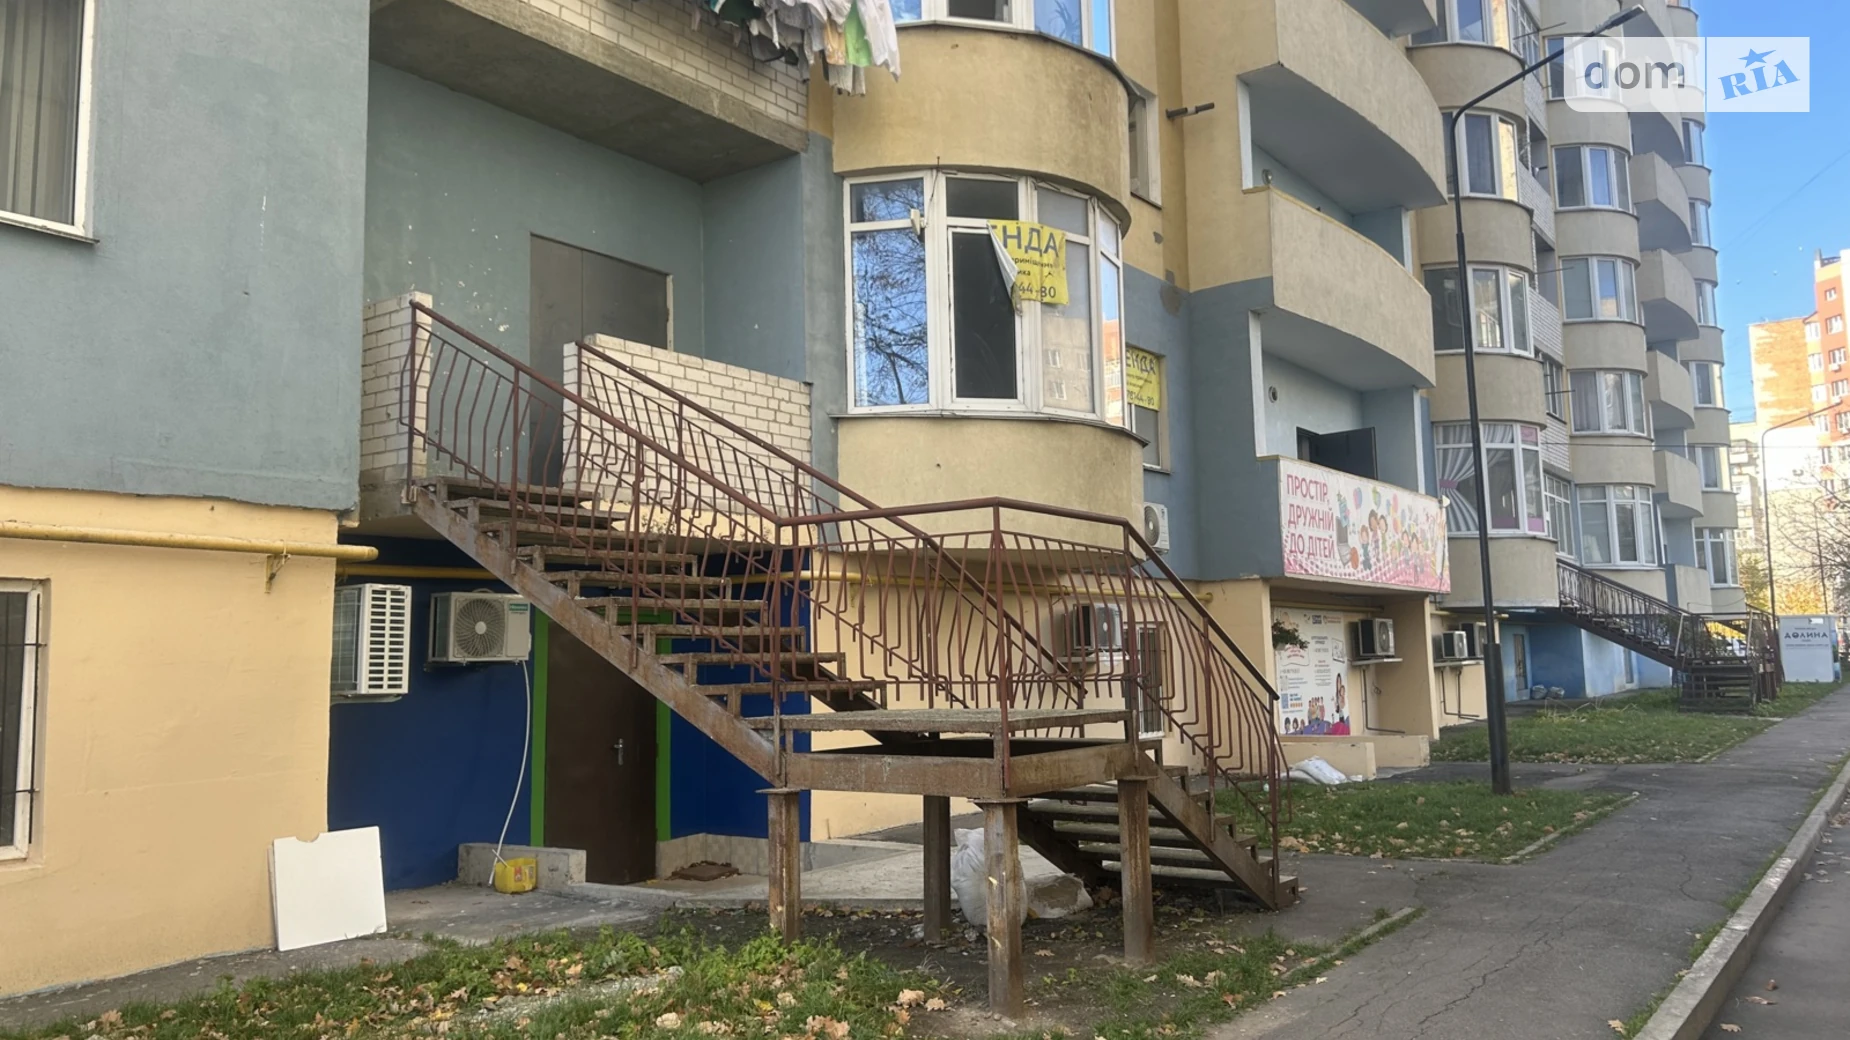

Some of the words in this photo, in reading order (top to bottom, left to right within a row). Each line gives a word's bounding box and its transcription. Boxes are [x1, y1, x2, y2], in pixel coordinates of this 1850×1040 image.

[989, 225, 1059, 257] НДА
[1286, 473, 1330, 506] ПРОСТІР,
[1288, 503, 1335, 532] ДРУЖНІЙ
[1289, 532, 1306, 555] ДО
[1307, 534, 1336, 560] ДІТЕЙ
